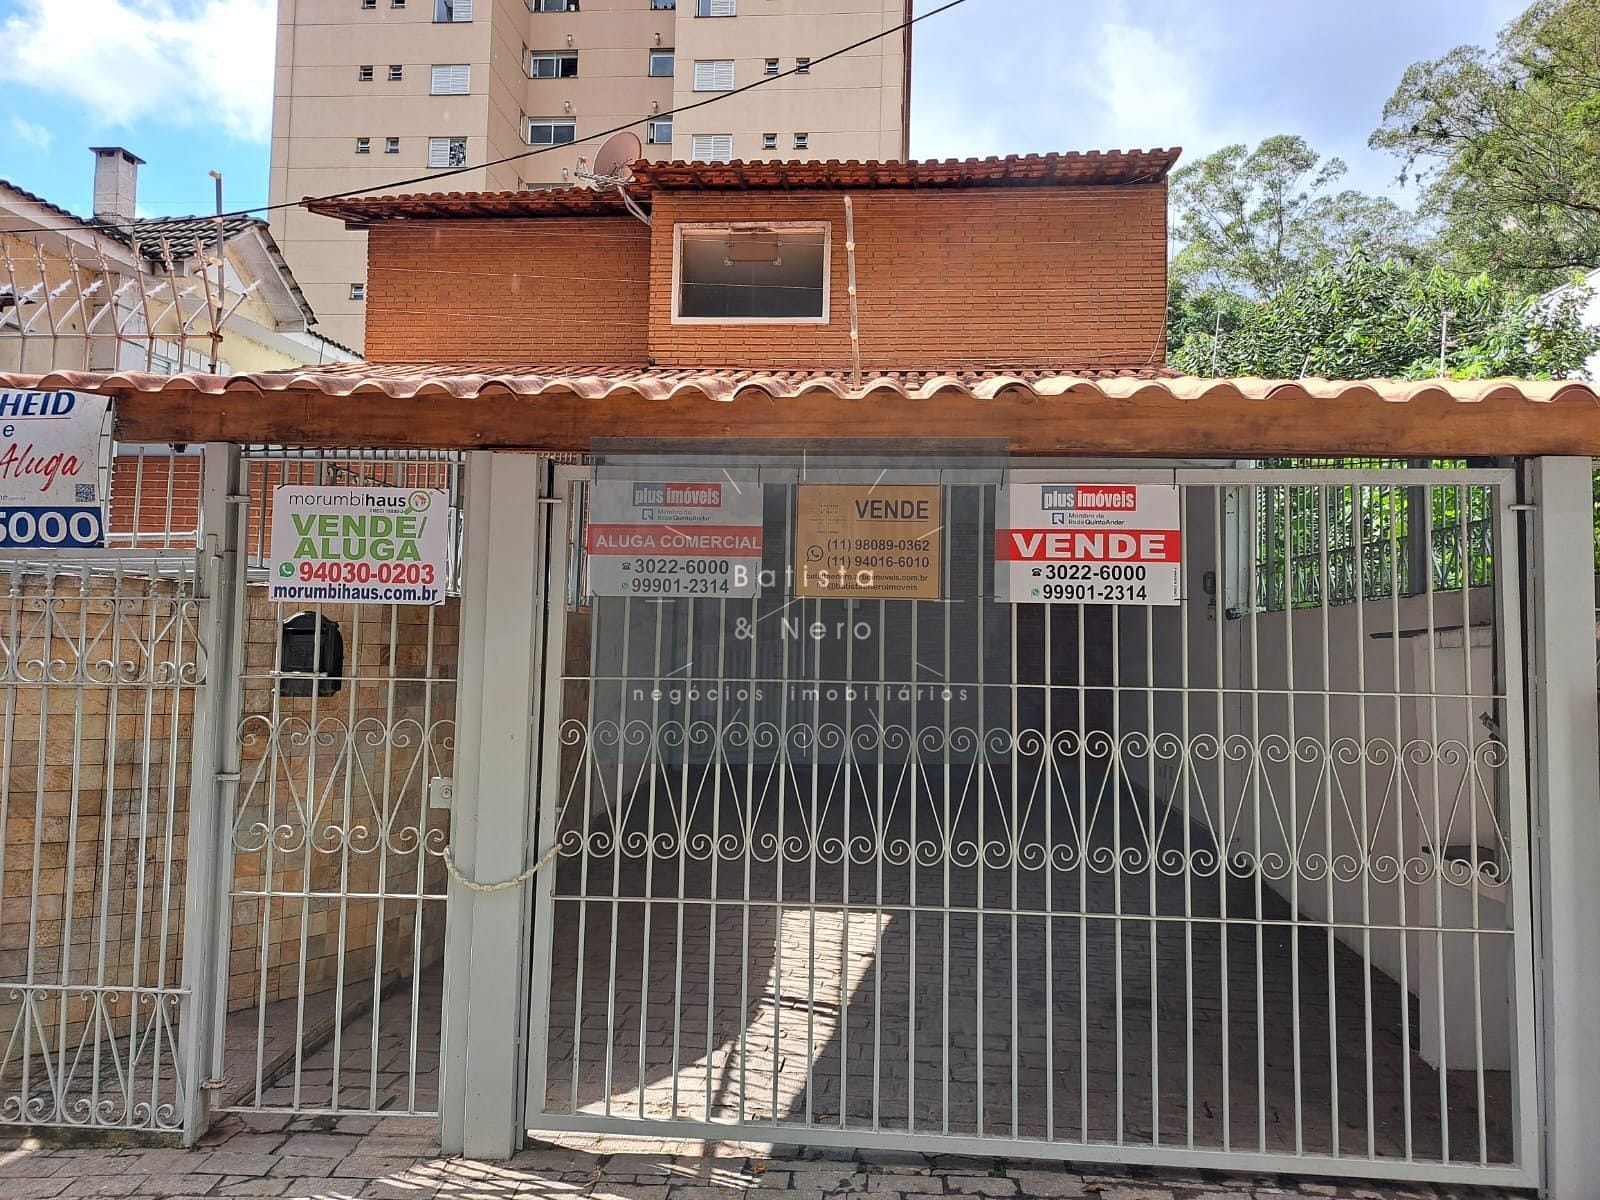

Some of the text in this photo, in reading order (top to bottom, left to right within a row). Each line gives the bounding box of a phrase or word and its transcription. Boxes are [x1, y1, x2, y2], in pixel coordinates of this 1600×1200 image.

[0, 391, 76, 416] HEID
[0, 443, 84, 491] Aluga
[289, 491, 407, 507] morumbihaus
[635, 486, 720, 506] plus imóveis
[1043, 489, 1135, 508] plus imóveis
[855, 499, 929, 520] VENDE
[0, 511, 99, 543] 000
[291, 514, 428, 539] VENDE/
[293, 537, 422, 562] ALUGA
[596, 535, 762, 550] ALUGA COMERCIAL
[827, 539, 930, 552] (11) 98089-0362
[1012, 533, 1166, 560] VENDE
[634, 558, 729, 575] 3022-6000
[827, 556, 929, 569] (11) 94016-6010
[300, 561, 435, 585] 94030-0203
[1045, 564, 1147, 581] 3022-6000
[274, 583, 438, 601] morumbihaus.com.br
[631, 578, 729, 594] 99901-2314
[1043, 584, 1147, 601] 99901-2314
